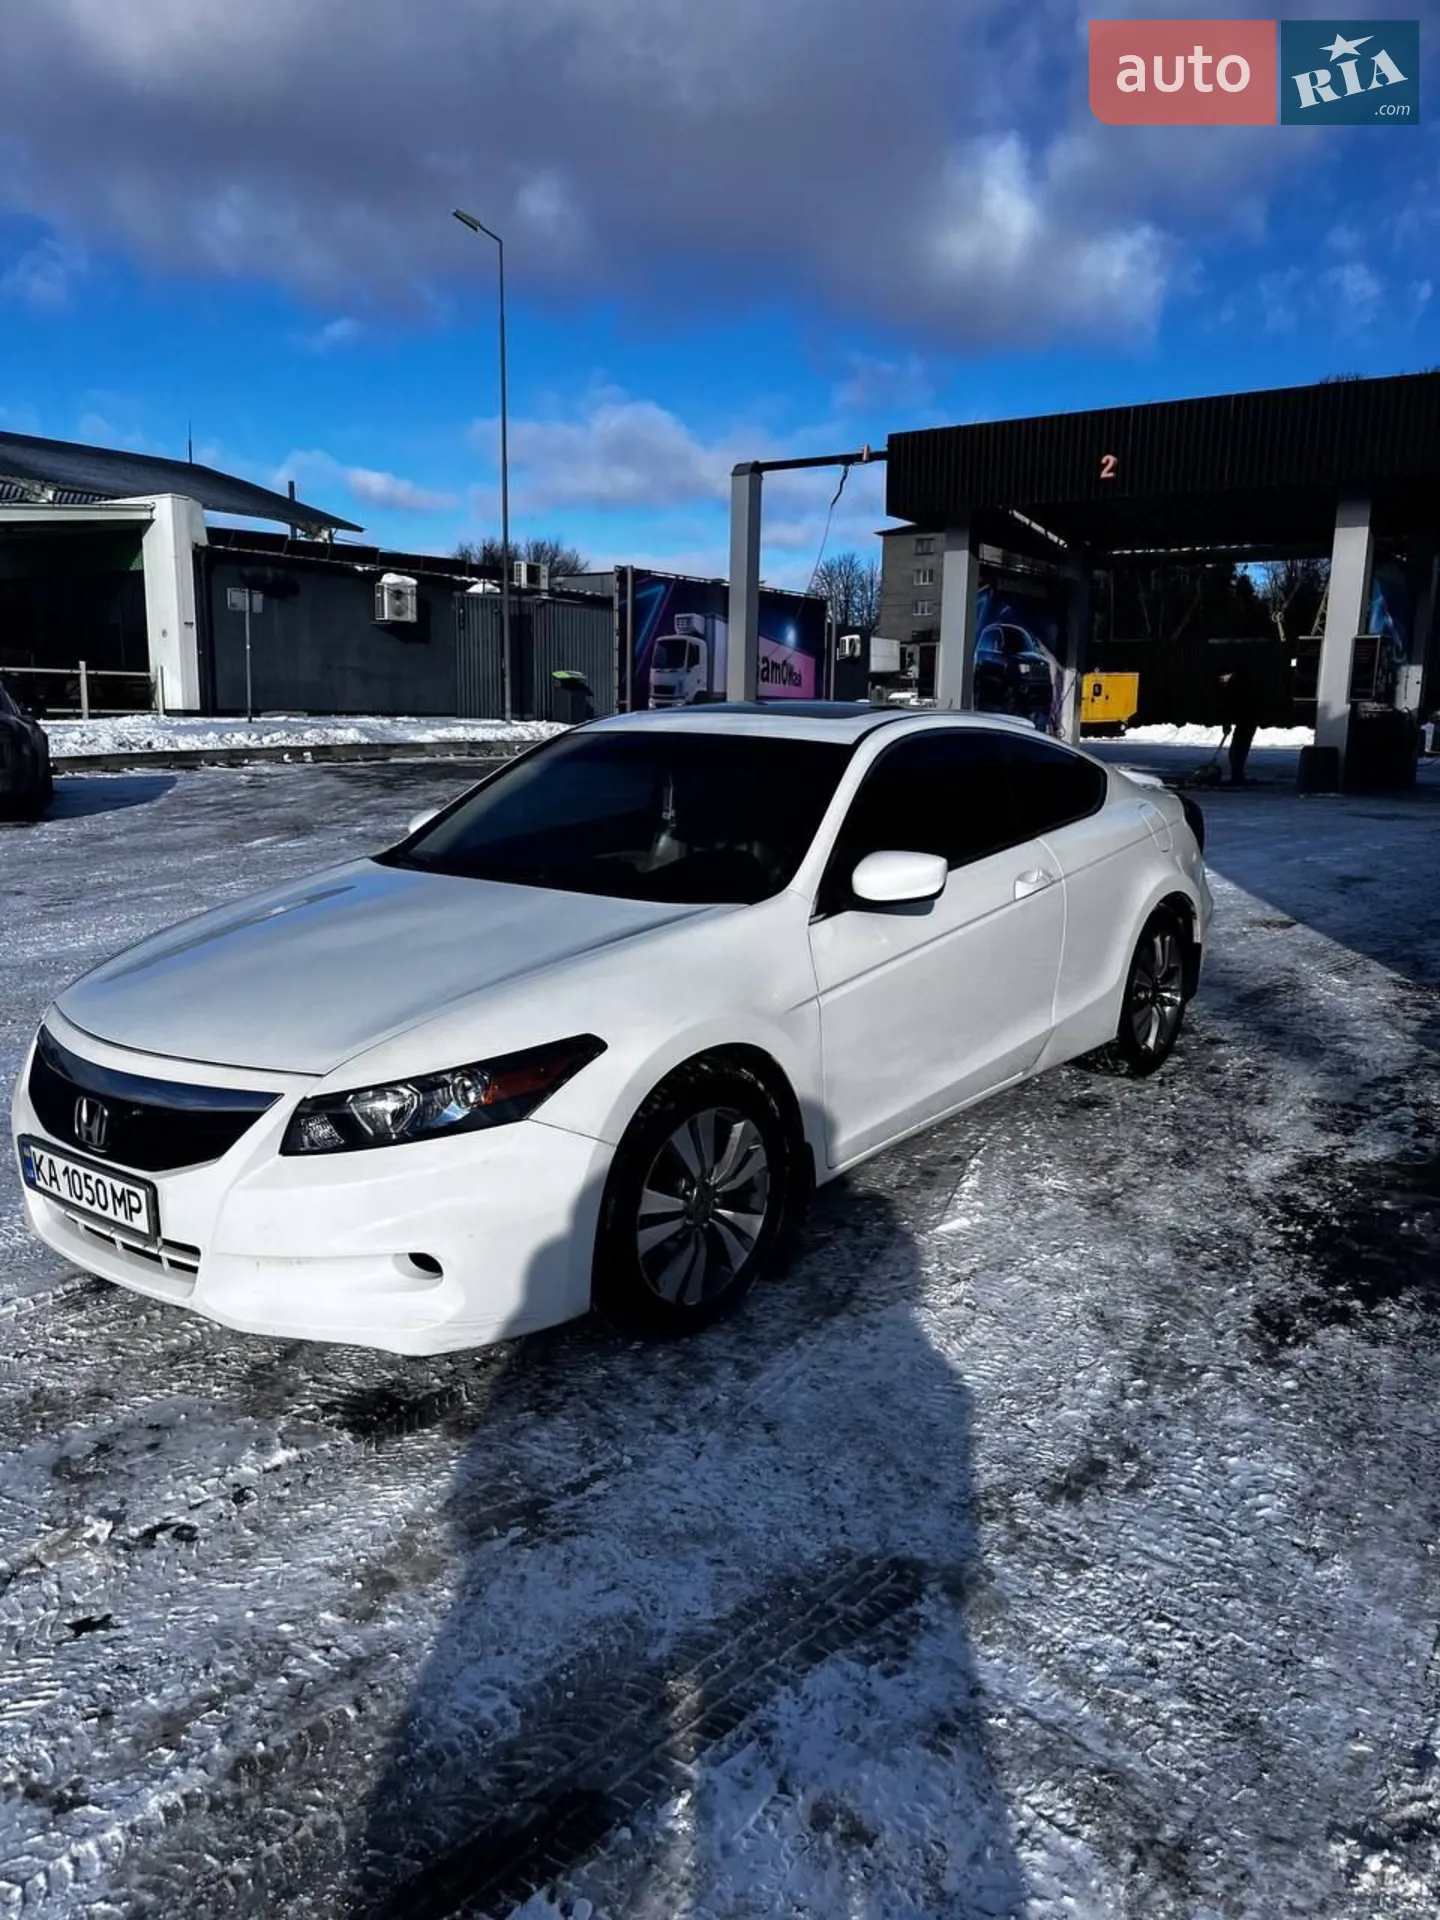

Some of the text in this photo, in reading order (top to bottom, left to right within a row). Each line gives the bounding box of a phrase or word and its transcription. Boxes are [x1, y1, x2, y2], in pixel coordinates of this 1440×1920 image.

[1100, 454, 1118, 478] 2
[32, 1150, 143, 1222] KA 1050 MP
